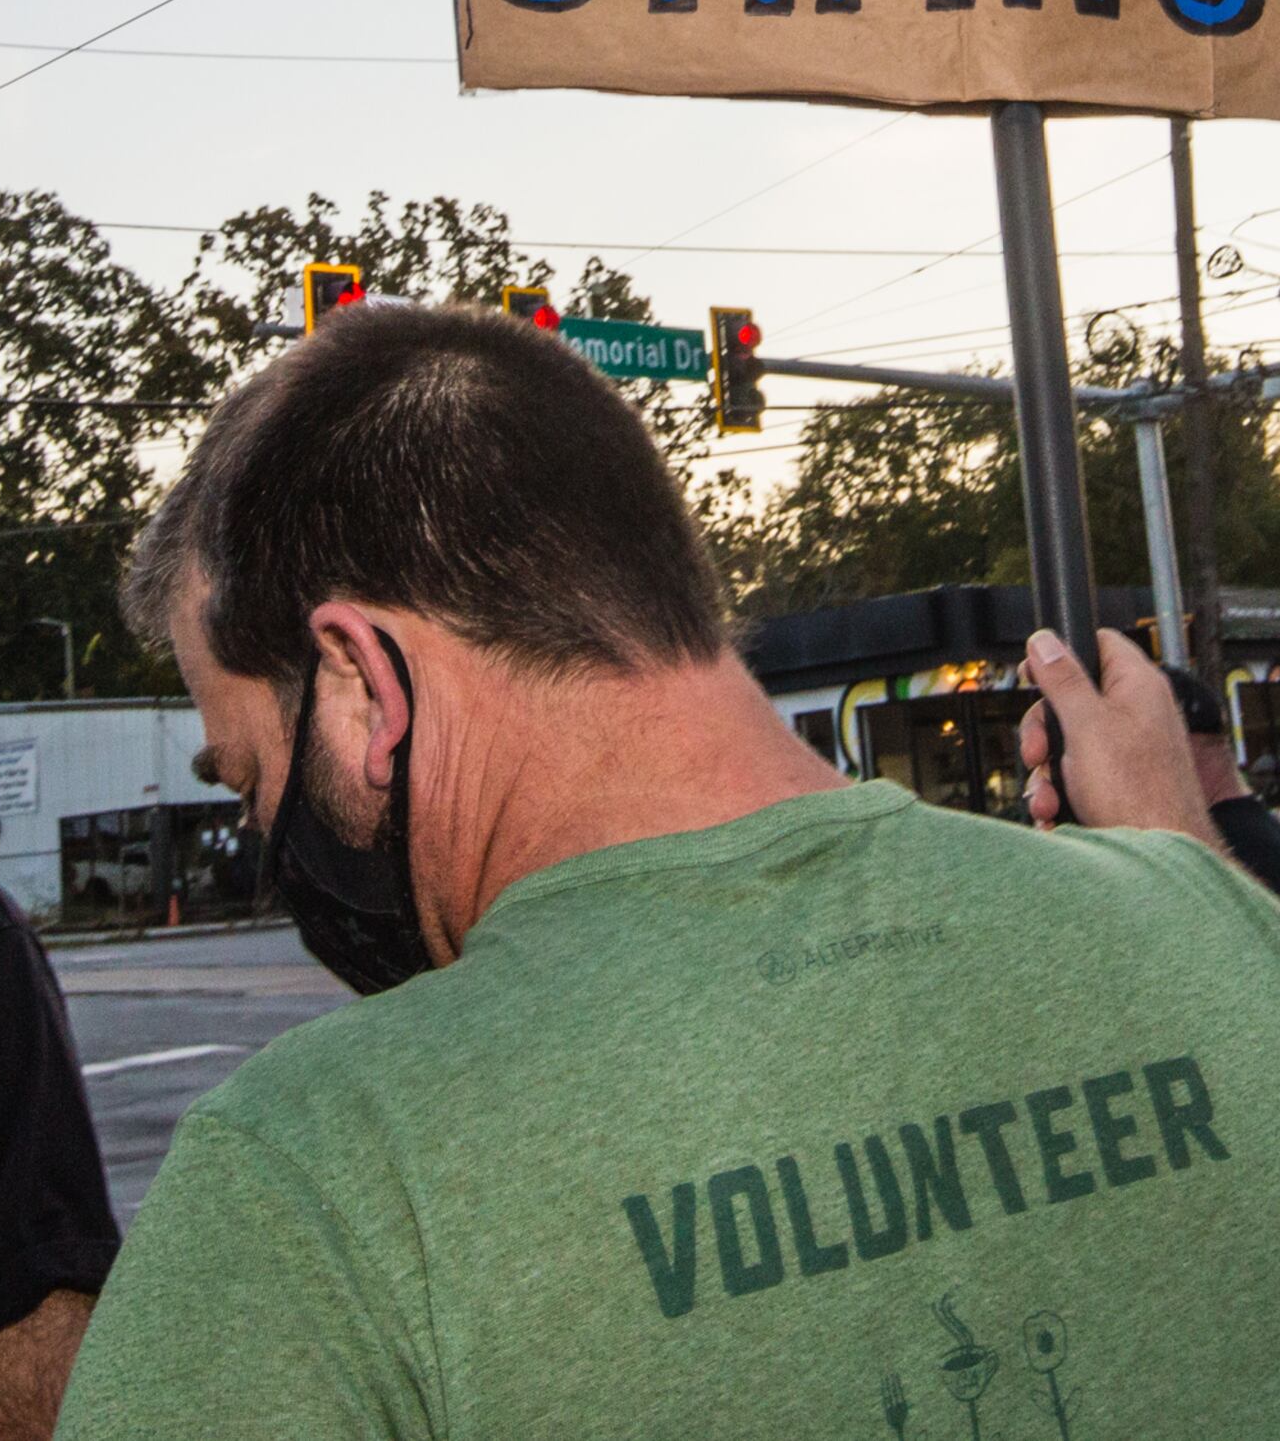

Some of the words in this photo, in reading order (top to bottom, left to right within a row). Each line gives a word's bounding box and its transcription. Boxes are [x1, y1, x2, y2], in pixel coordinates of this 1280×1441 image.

[560, 328, 667, 369] emorial
[673, 339, 703, 370] Dr
[805, 923, 946, 969] ALTERNATIVE
[622, 1055, 1231, 1319] VOLUNTEER
